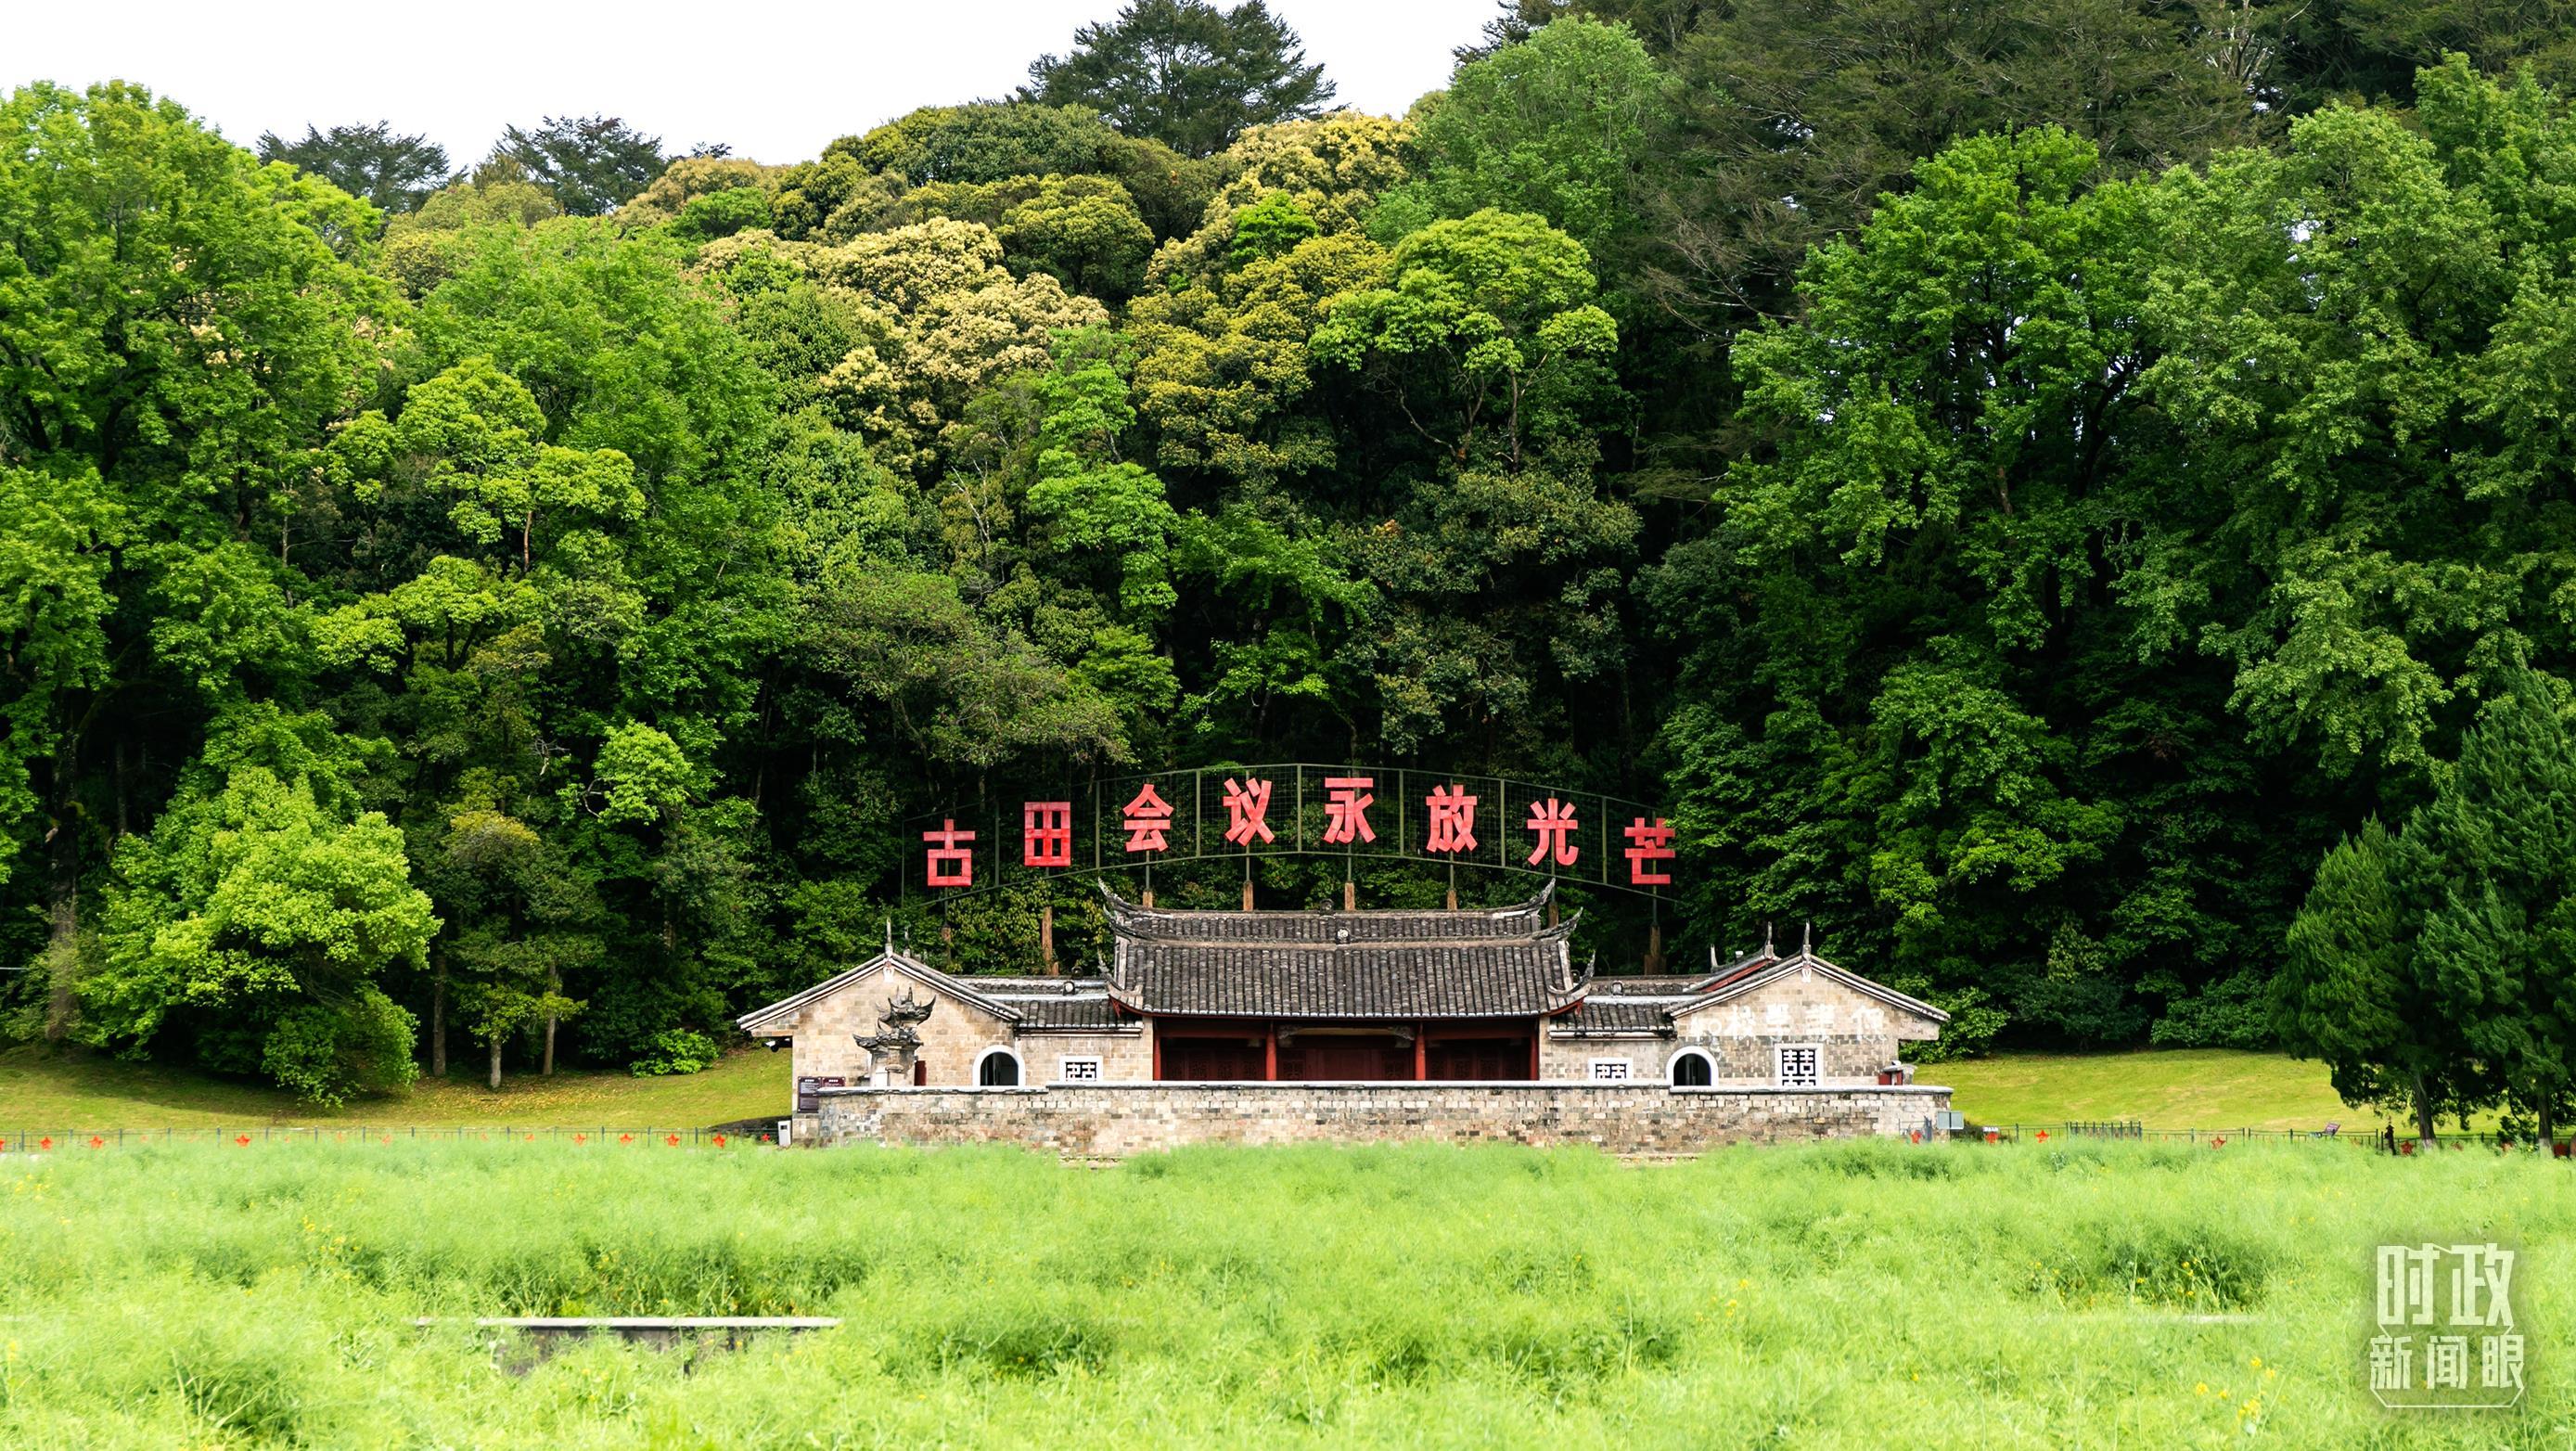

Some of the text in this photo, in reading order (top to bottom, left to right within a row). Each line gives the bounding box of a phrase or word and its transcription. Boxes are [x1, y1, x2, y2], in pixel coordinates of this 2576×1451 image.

[924, 777, 1675, 884] 古田会议永放光芒
